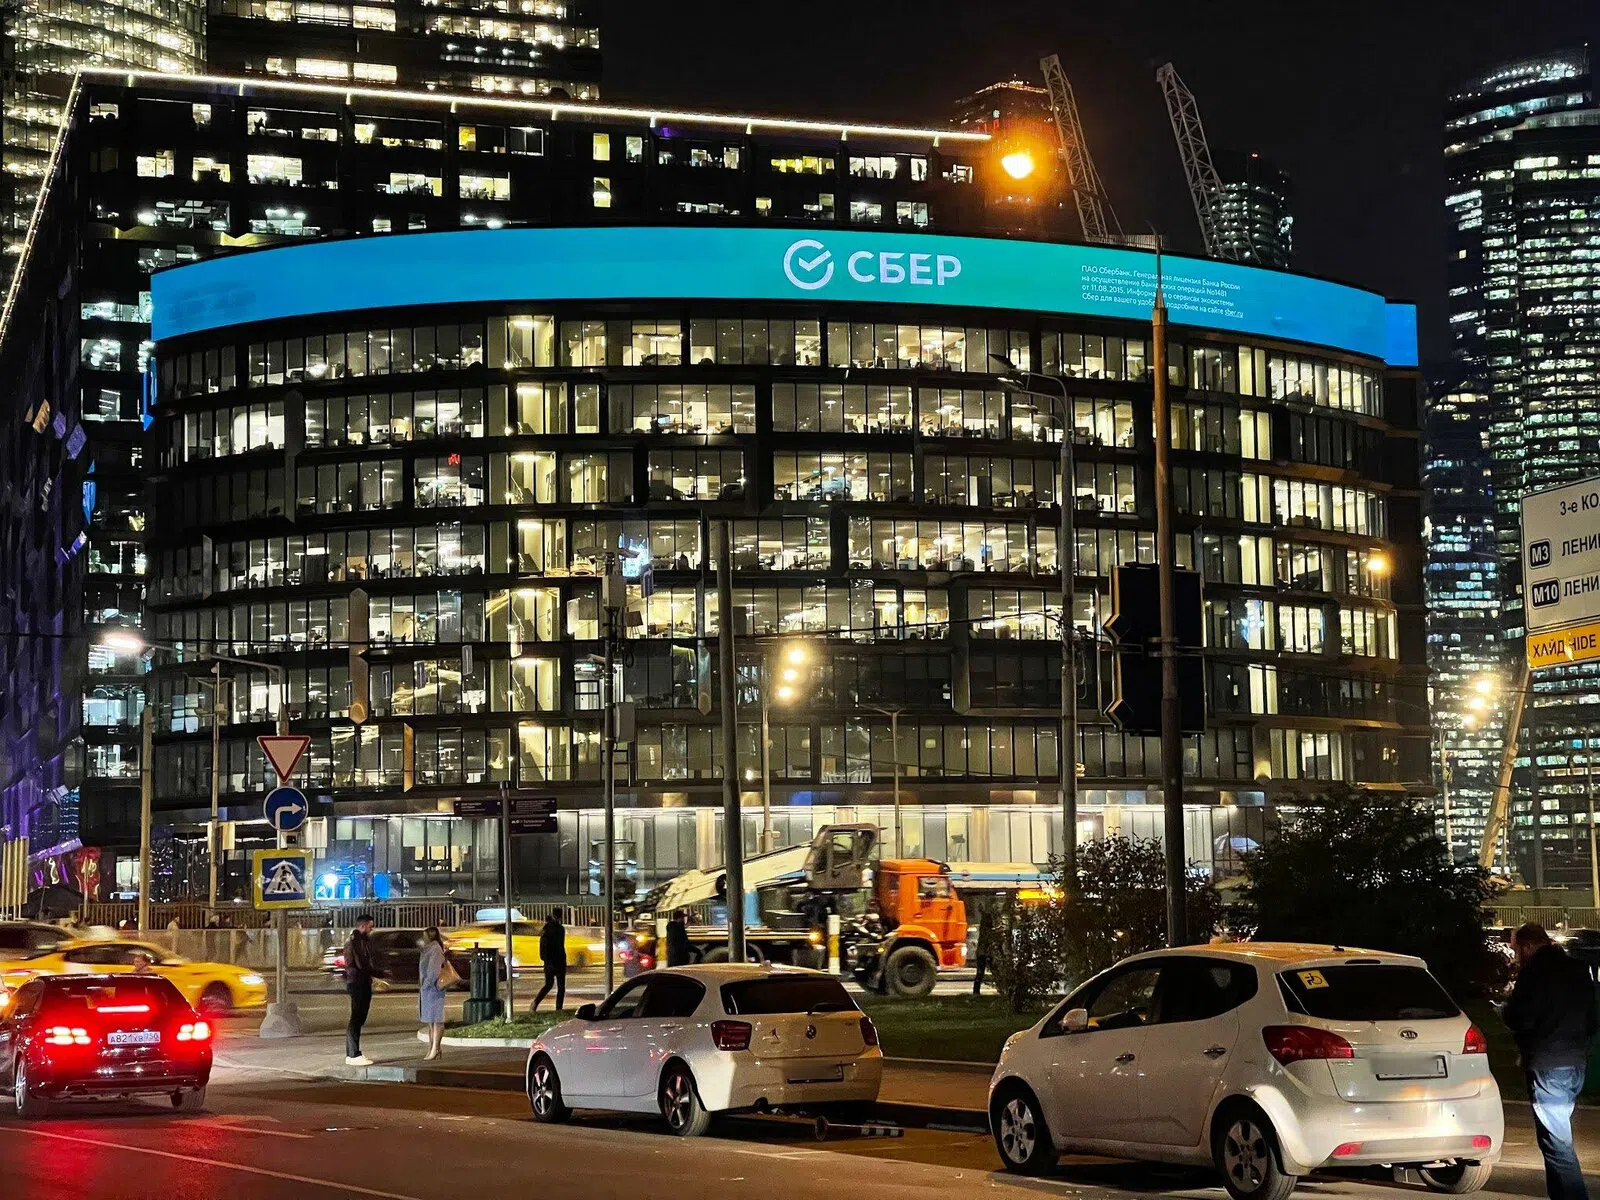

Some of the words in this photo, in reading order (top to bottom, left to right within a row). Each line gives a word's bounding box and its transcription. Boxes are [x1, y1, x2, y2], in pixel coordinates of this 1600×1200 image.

[848, 251, 962, 285] СБЕР
[1081, 265, 1098, 273] ПАО
[1133, 270, 1172, 281] Генералная
[1202, 278, 1220, 288] Банка
[1220, 281, 1240, 290] России
[1082, 292, 1099, 301] Сбер
[1114, 296, 1136, 304] вашего
[1208, 306, 1224, 314] сайте
[1126, 288, 1167, 298] Информая
[1582, 493, 1600, 510] КО
[1533, 638, 1566, 658] ХАЙД
